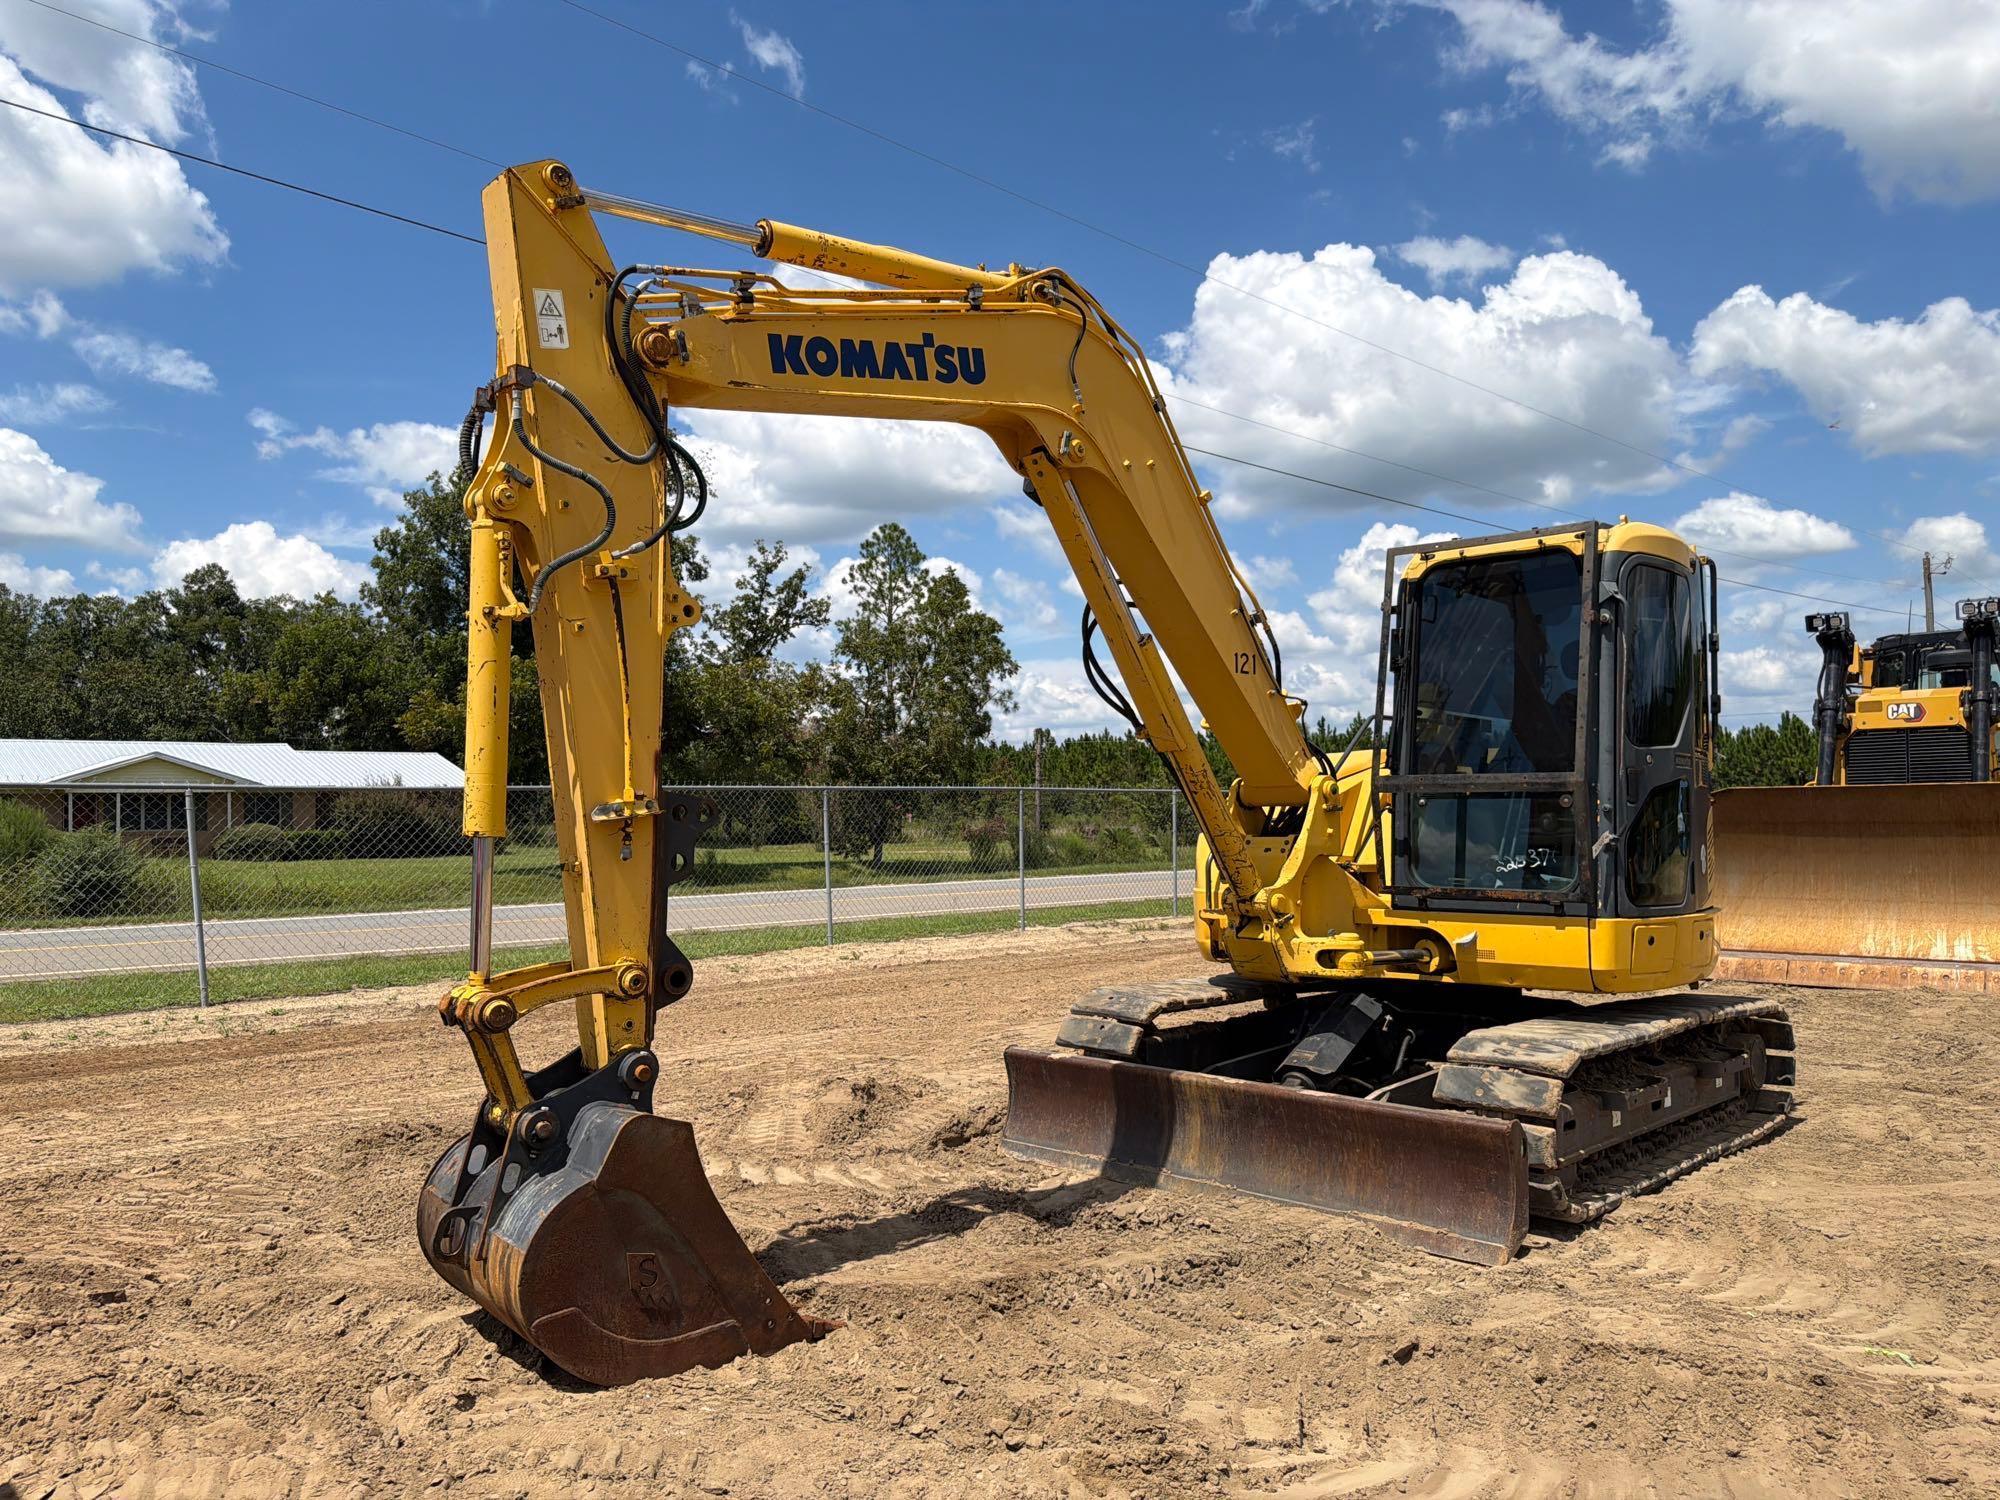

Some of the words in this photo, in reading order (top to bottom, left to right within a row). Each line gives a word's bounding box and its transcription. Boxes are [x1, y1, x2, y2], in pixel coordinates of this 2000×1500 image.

[767, 332, 986, 385] KOMATSU
[1234, 652, 1256, 675] 121
[1887, 703, 1917, 719] CAT
